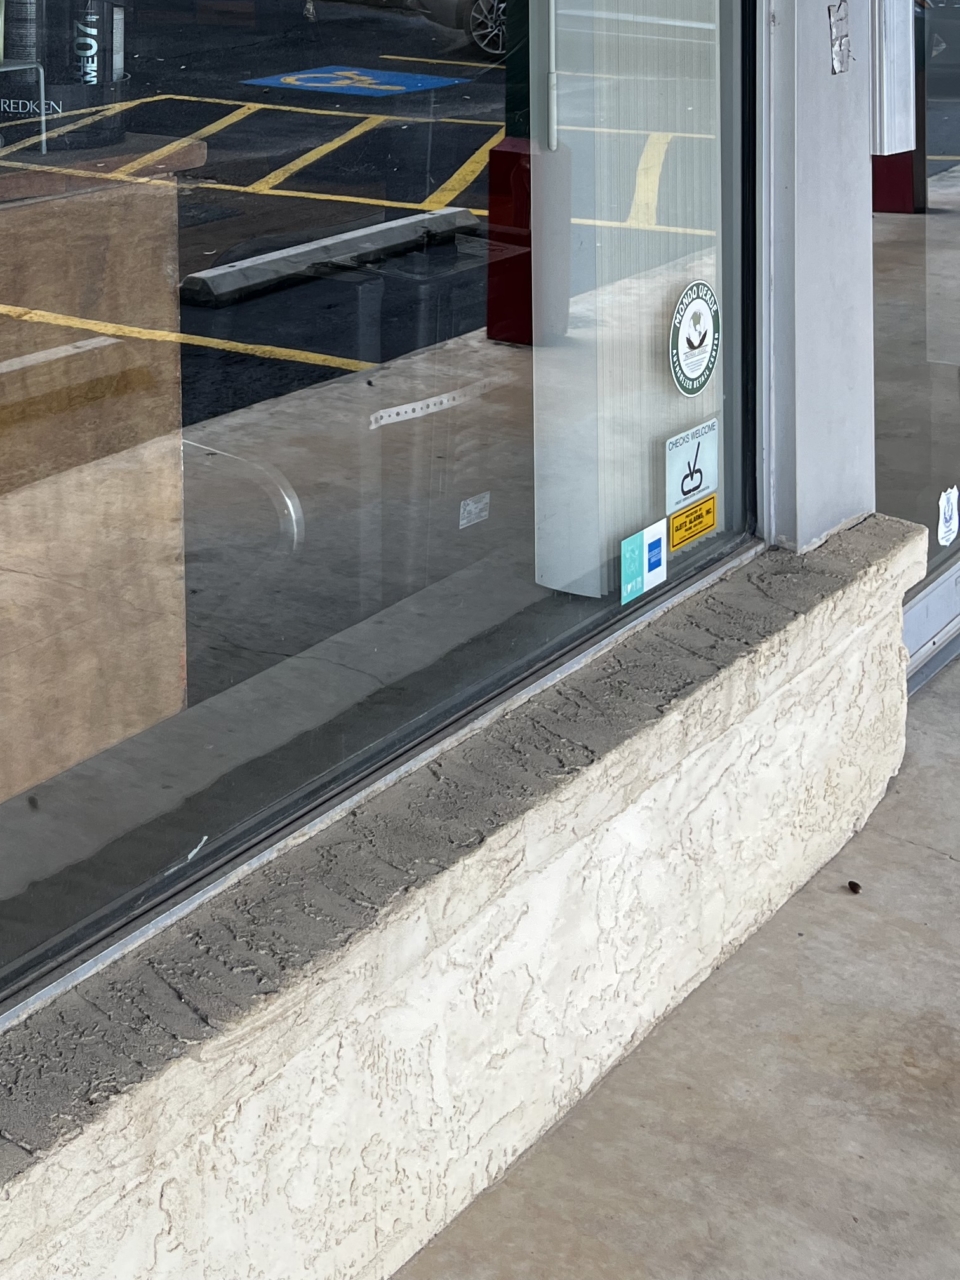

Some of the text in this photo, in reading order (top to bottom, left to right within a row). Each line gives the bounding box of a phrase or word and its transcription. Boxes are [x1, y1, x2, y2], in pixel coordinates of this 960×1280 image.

[0, 98, 63, 114] REDKEN
[674, 284, 718, 328] MONDO VERDE
[672, 349, 693, 389] AUTHORIZED
[708, 332, 719, 369] CENTER
[668, 421, 716, 451] CHECKS WELCOME
